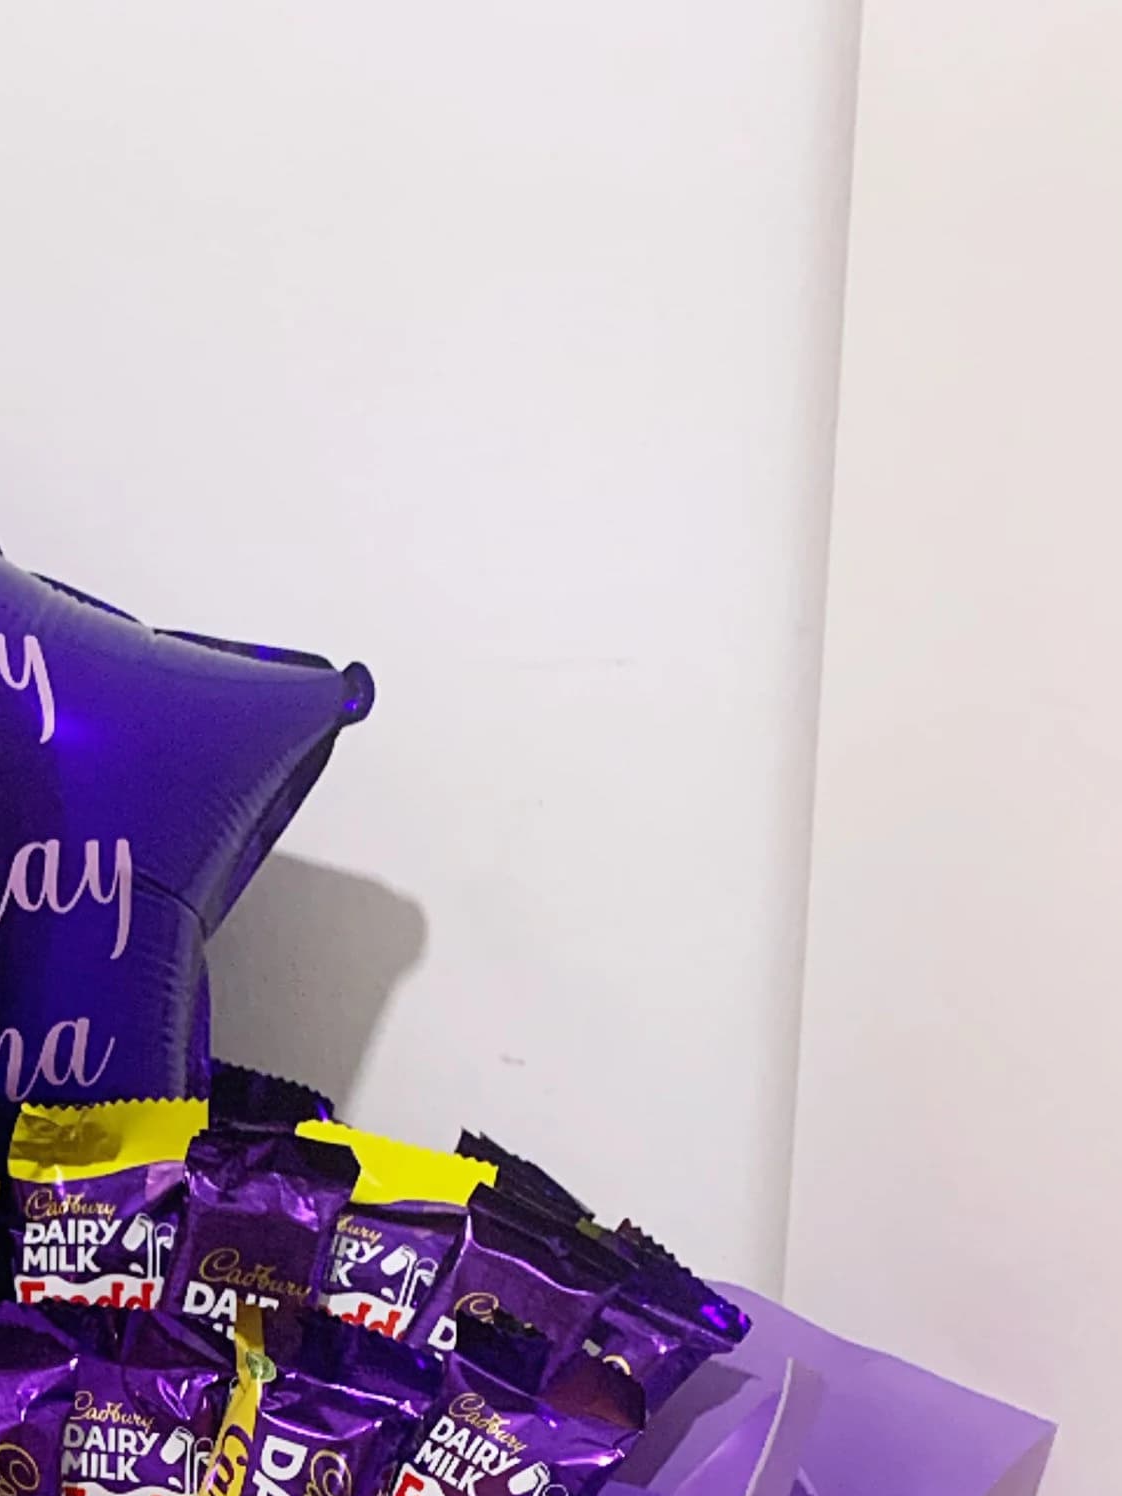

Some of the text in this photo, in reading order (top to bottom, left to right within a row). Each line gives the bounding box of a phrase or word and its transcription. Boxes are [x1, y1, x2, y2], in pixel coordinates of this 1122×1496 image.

[24, 1189, 116, 1220] Cadbury
[23, 1218, 122, 1246] DAIRY
[23, 1246, 102, 1273] MILK
[199, 1247, 312, 1298] Cadbury
[69, 1390, 156, 1431] Cadbury
[449, 1392, 527, 1454] Cadbury
[63, 1423, 161, 1456] DAIRY
[428, 1415, 521, 1479] DAIRY
[61, 1450, 141, 1483] MILK
